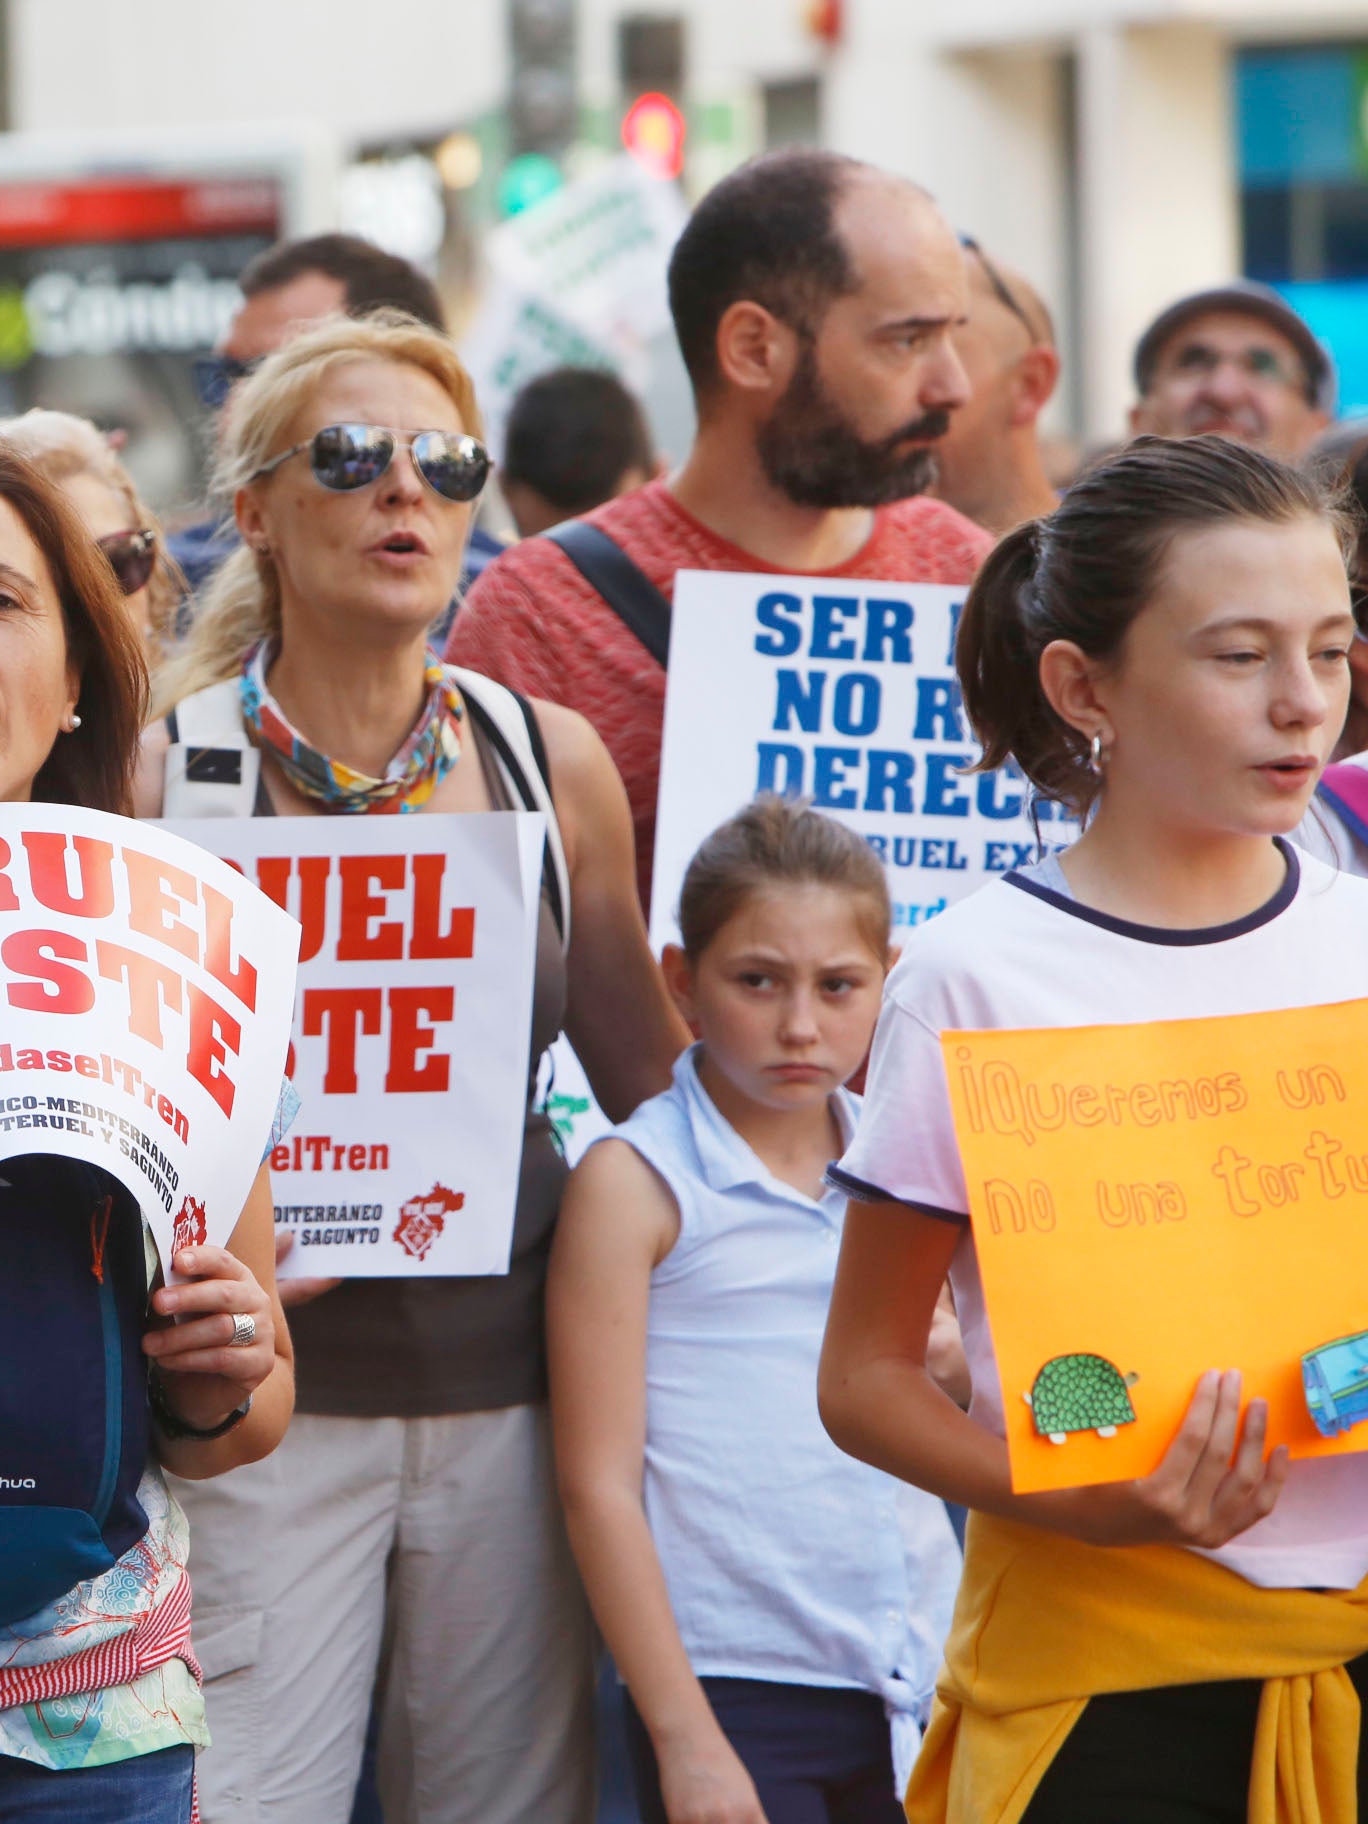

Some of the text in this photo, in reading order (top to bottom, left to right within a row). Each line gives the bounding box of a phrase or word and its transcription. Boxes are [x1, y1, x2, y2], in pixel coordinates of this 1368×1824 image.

[753, 592, 915, 665] SER
[772, 669, 882, 737] NO
[232, 854, 476, 964] UEL
[1276, 1064, 1347, 1109] un
[101, 1126, 114, 1145] Y
[119, 1137, 174, 1214] SAGUNTO
[300, 1227, 381, 1246] SAGUNTO
[984, 1178, 1057, 1235] no
[1095, 1180, 1188, 1227] una
